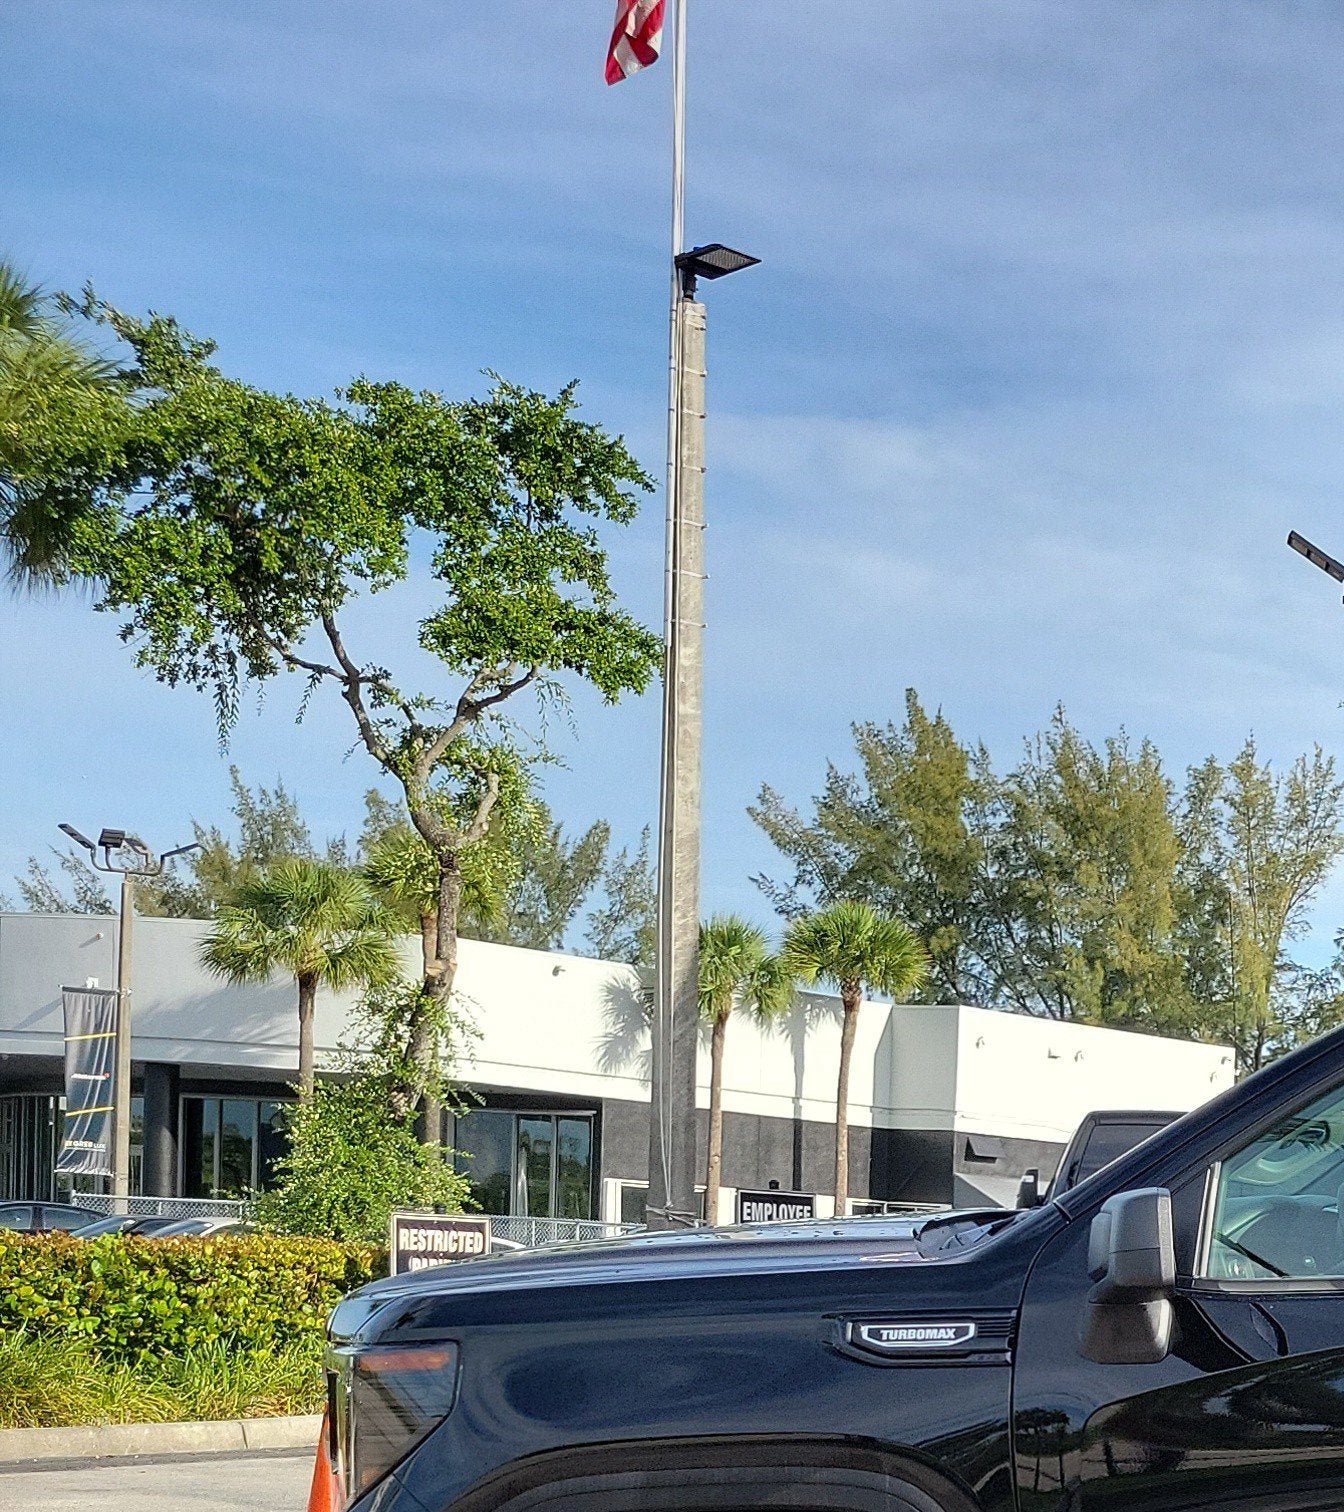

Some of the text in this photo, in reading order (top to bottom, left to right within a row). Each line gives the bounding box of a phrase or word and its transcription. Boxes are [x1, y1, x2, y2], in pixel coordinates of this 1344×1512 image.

[743, 1201, 812, 1221] EMPLOYEE
[399, 1228, 484, 1253] RESTRICTED
[880, 1328, 956, 1341] TURBOMAX
